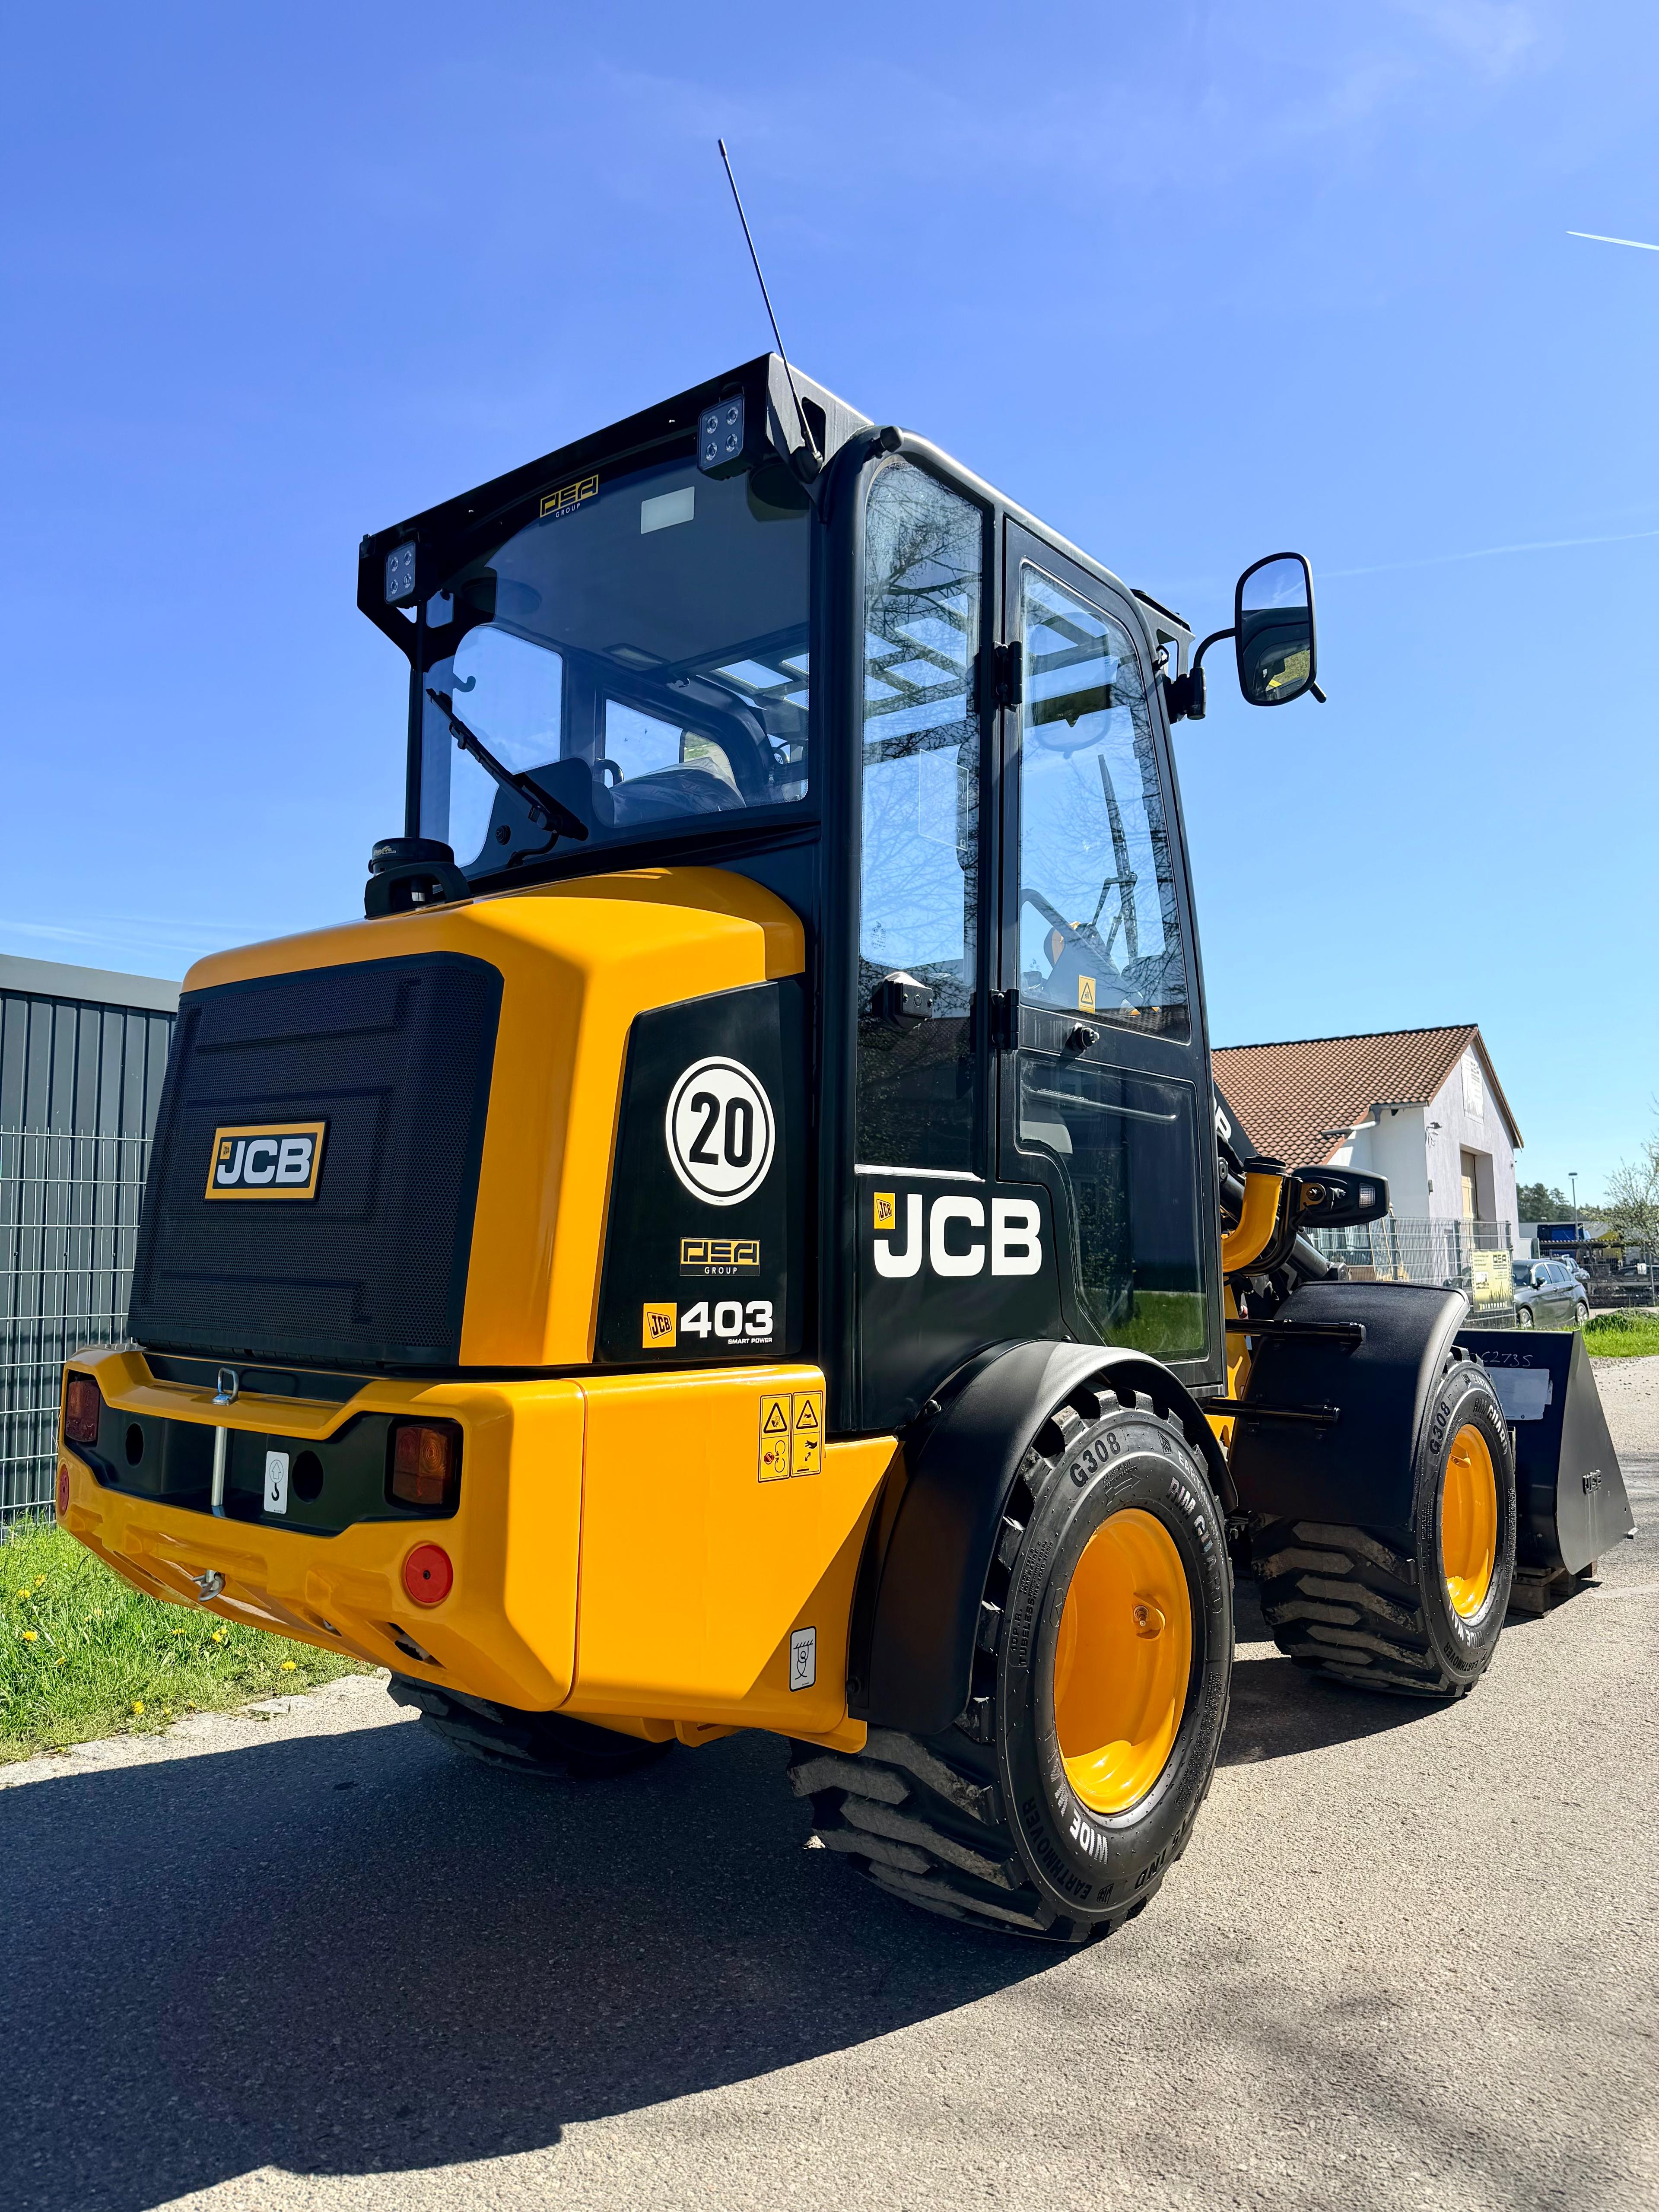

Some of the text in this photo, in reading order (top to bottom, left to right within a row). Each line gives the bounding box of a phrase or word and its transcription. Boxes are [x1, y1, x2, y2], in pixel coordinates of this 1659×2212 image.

[556, 503, 581, 518] GROUP
[689, 1091, 753, 1168] 20
[217, 1138, 312, 1184] JCB
[878, 1200, 892, 1220] JCB
[874, 1193, 1042, 1278] JCB
[649, 1300, 773, 1338] JCB 403
[1429, 1401, 1450, 1456] G308
[1473, 1398, 1508, 1455] RIM GUARD
[1070, 1432, 1121, 1488] G308
[1166, 1476, 1196, 1519] RIM
[1018, 1598, 1035, 1666] TUBELESS
[1443, 1641, 1479, 1672] EARTHMOVER
[1465, 1629, 1485, 1649] WIDE
[1022, 1796, 1093, 1900] EARTHMOVER
[1069, 1807, 1109, 1865] WIDE
[1135, 1850, 1166, 1890] IND
